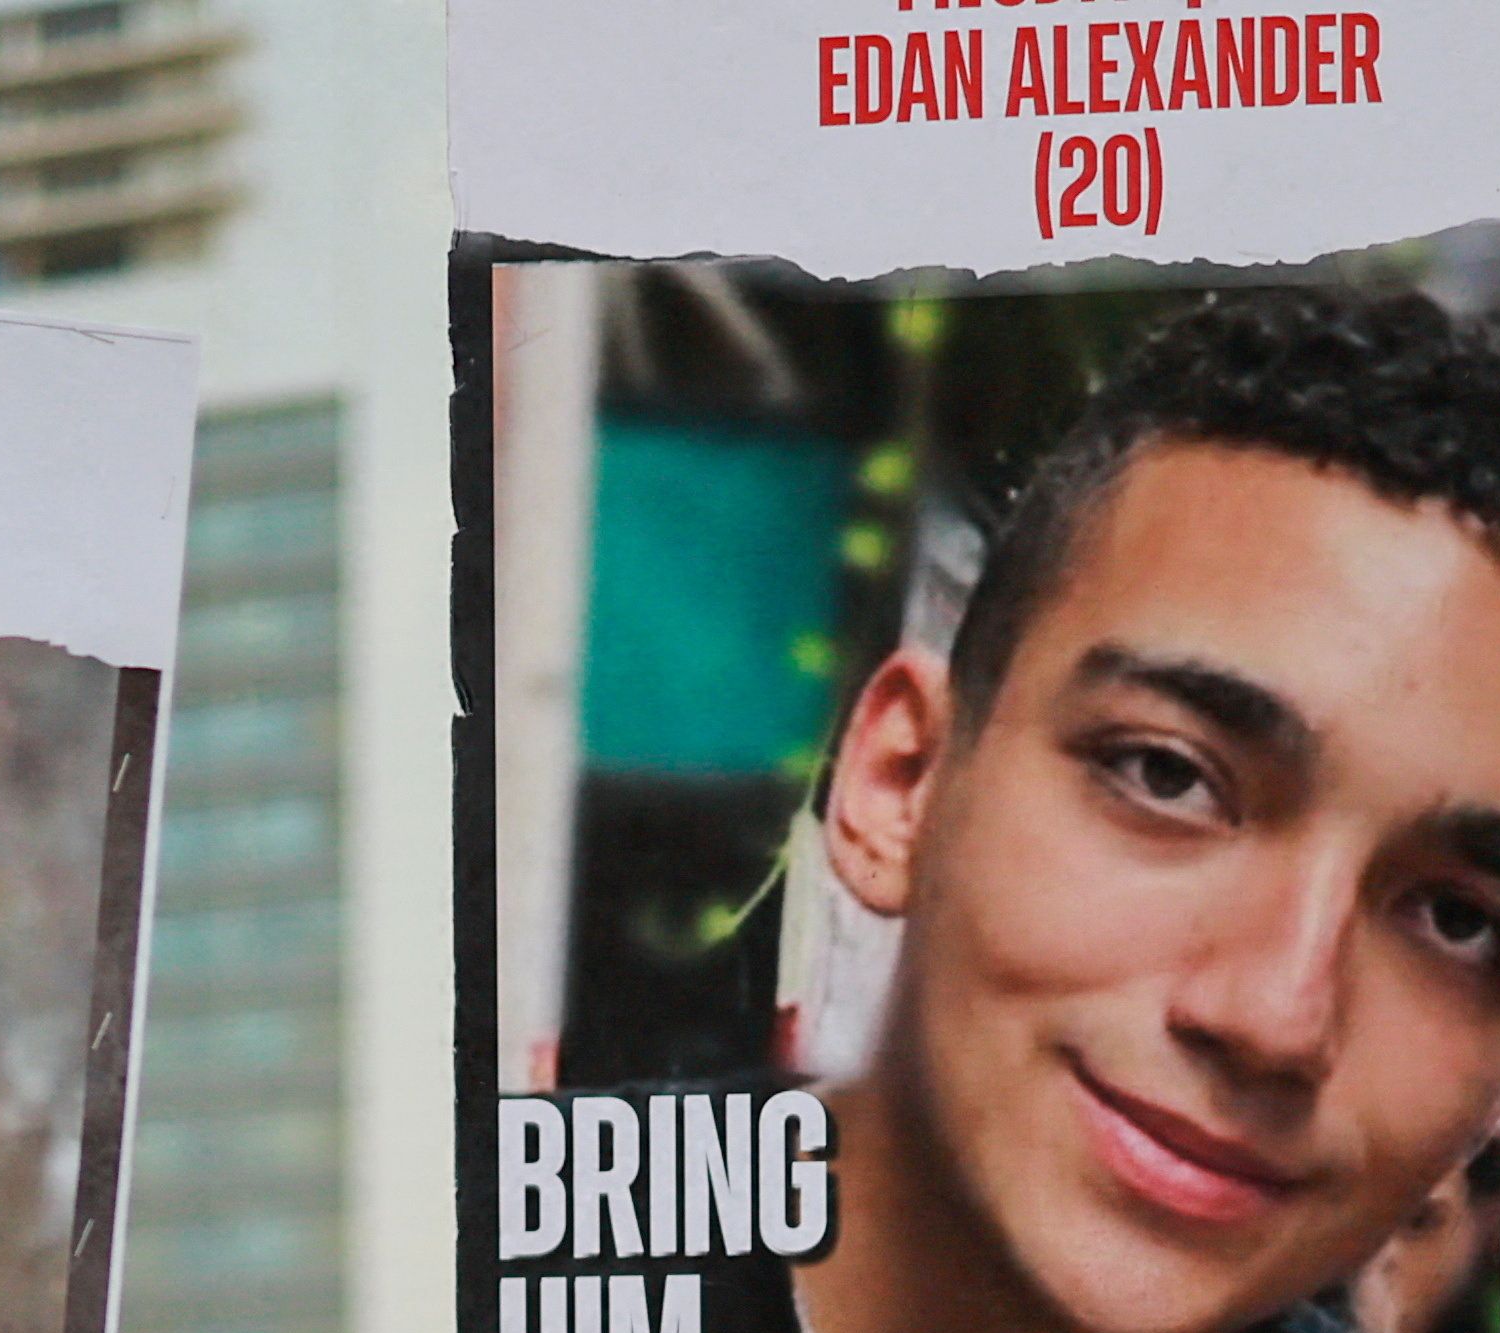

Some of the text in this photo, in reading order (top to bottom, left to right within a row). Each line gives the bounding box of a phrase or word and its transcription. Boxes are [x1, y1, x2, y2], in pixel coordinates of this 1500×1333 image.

[818, 12, 1383, 126] EDAN ALEXANDER
[1035, 127, 1164, 240] (20)
[496, 1089, 828, 1261] BRING
